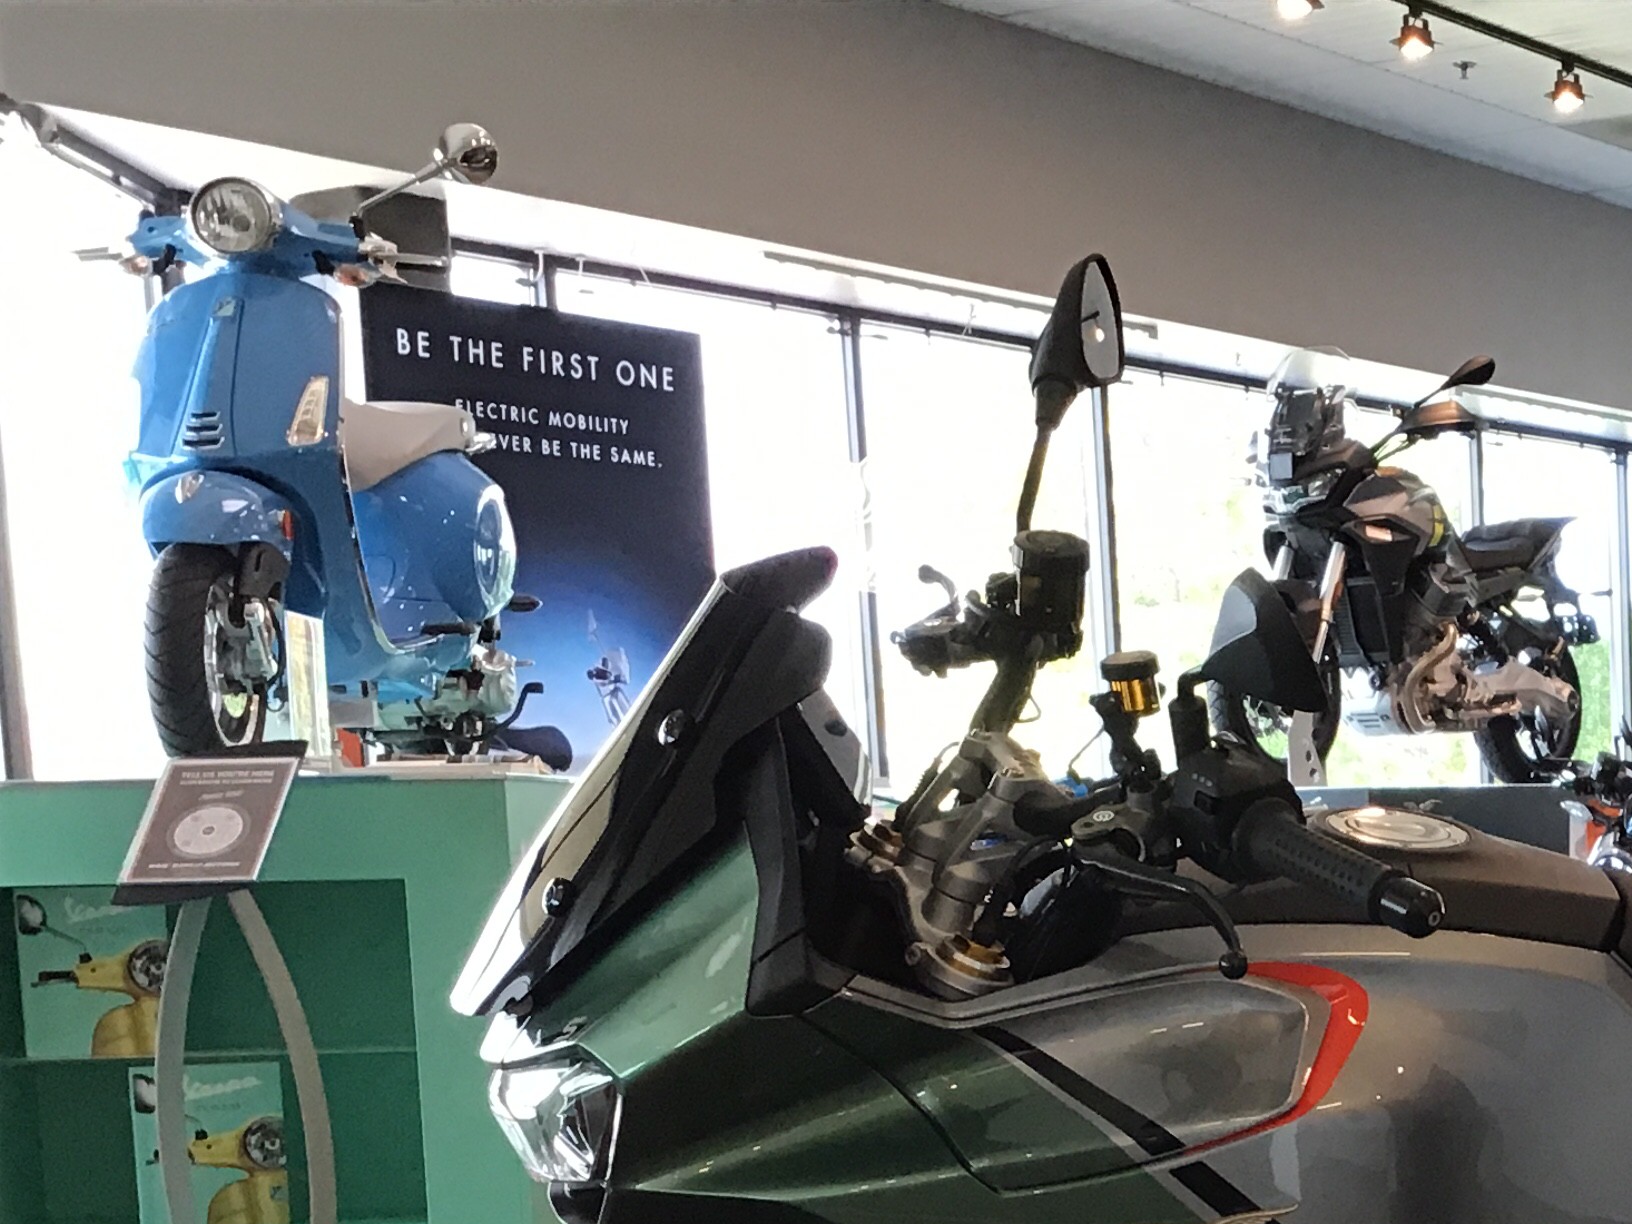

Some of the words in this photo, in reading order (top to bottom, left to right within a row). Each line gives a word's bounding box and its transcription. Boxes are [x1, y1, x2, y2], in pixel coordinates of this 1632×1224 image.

[396, 328, 431, 358] BE
[450, 336, 504, 368] THE
[522, 346, 599, 381] FIRST
[616, 360, 675, 392] ONE
[548, 411, 630, 435] MOBILITY
[541, 438, 562, 457] BE
[570, 442, 601, 461] THE
[610, 447, 664, 468] SAME.
